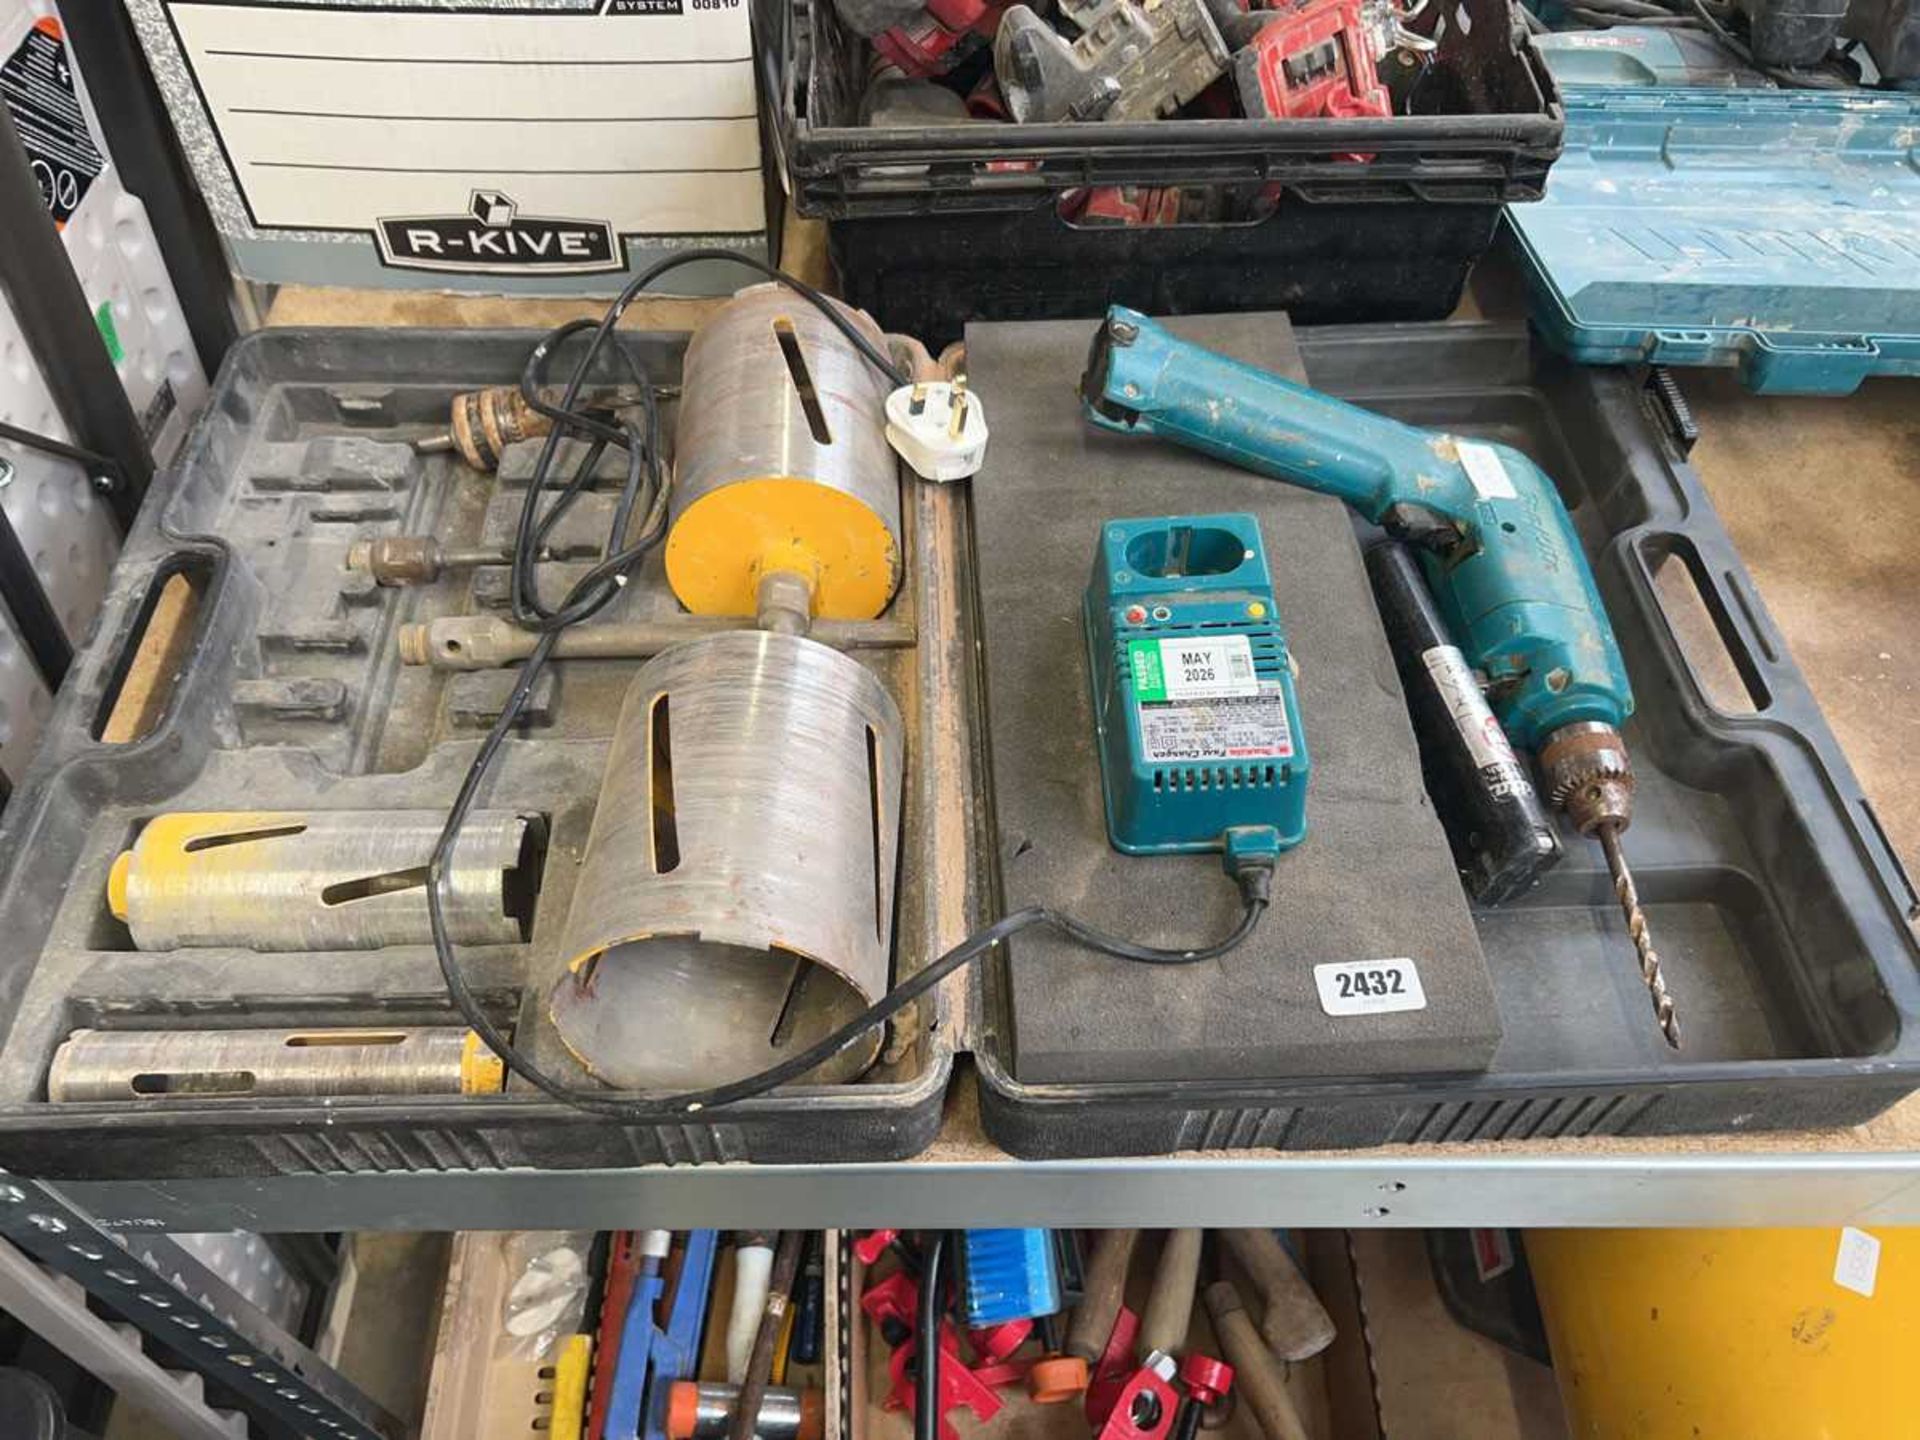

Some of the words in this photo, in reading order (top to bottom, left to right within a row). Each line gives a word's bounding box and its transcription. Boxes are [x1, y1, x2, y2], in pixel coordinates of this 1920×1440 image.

[616, 0, 679, 10] SYSTEM
[1181, 652, 1212, 666] MAY
[1184, 668, 1216, 682] 2026
[1335, 969, 1406, 998] 2432
